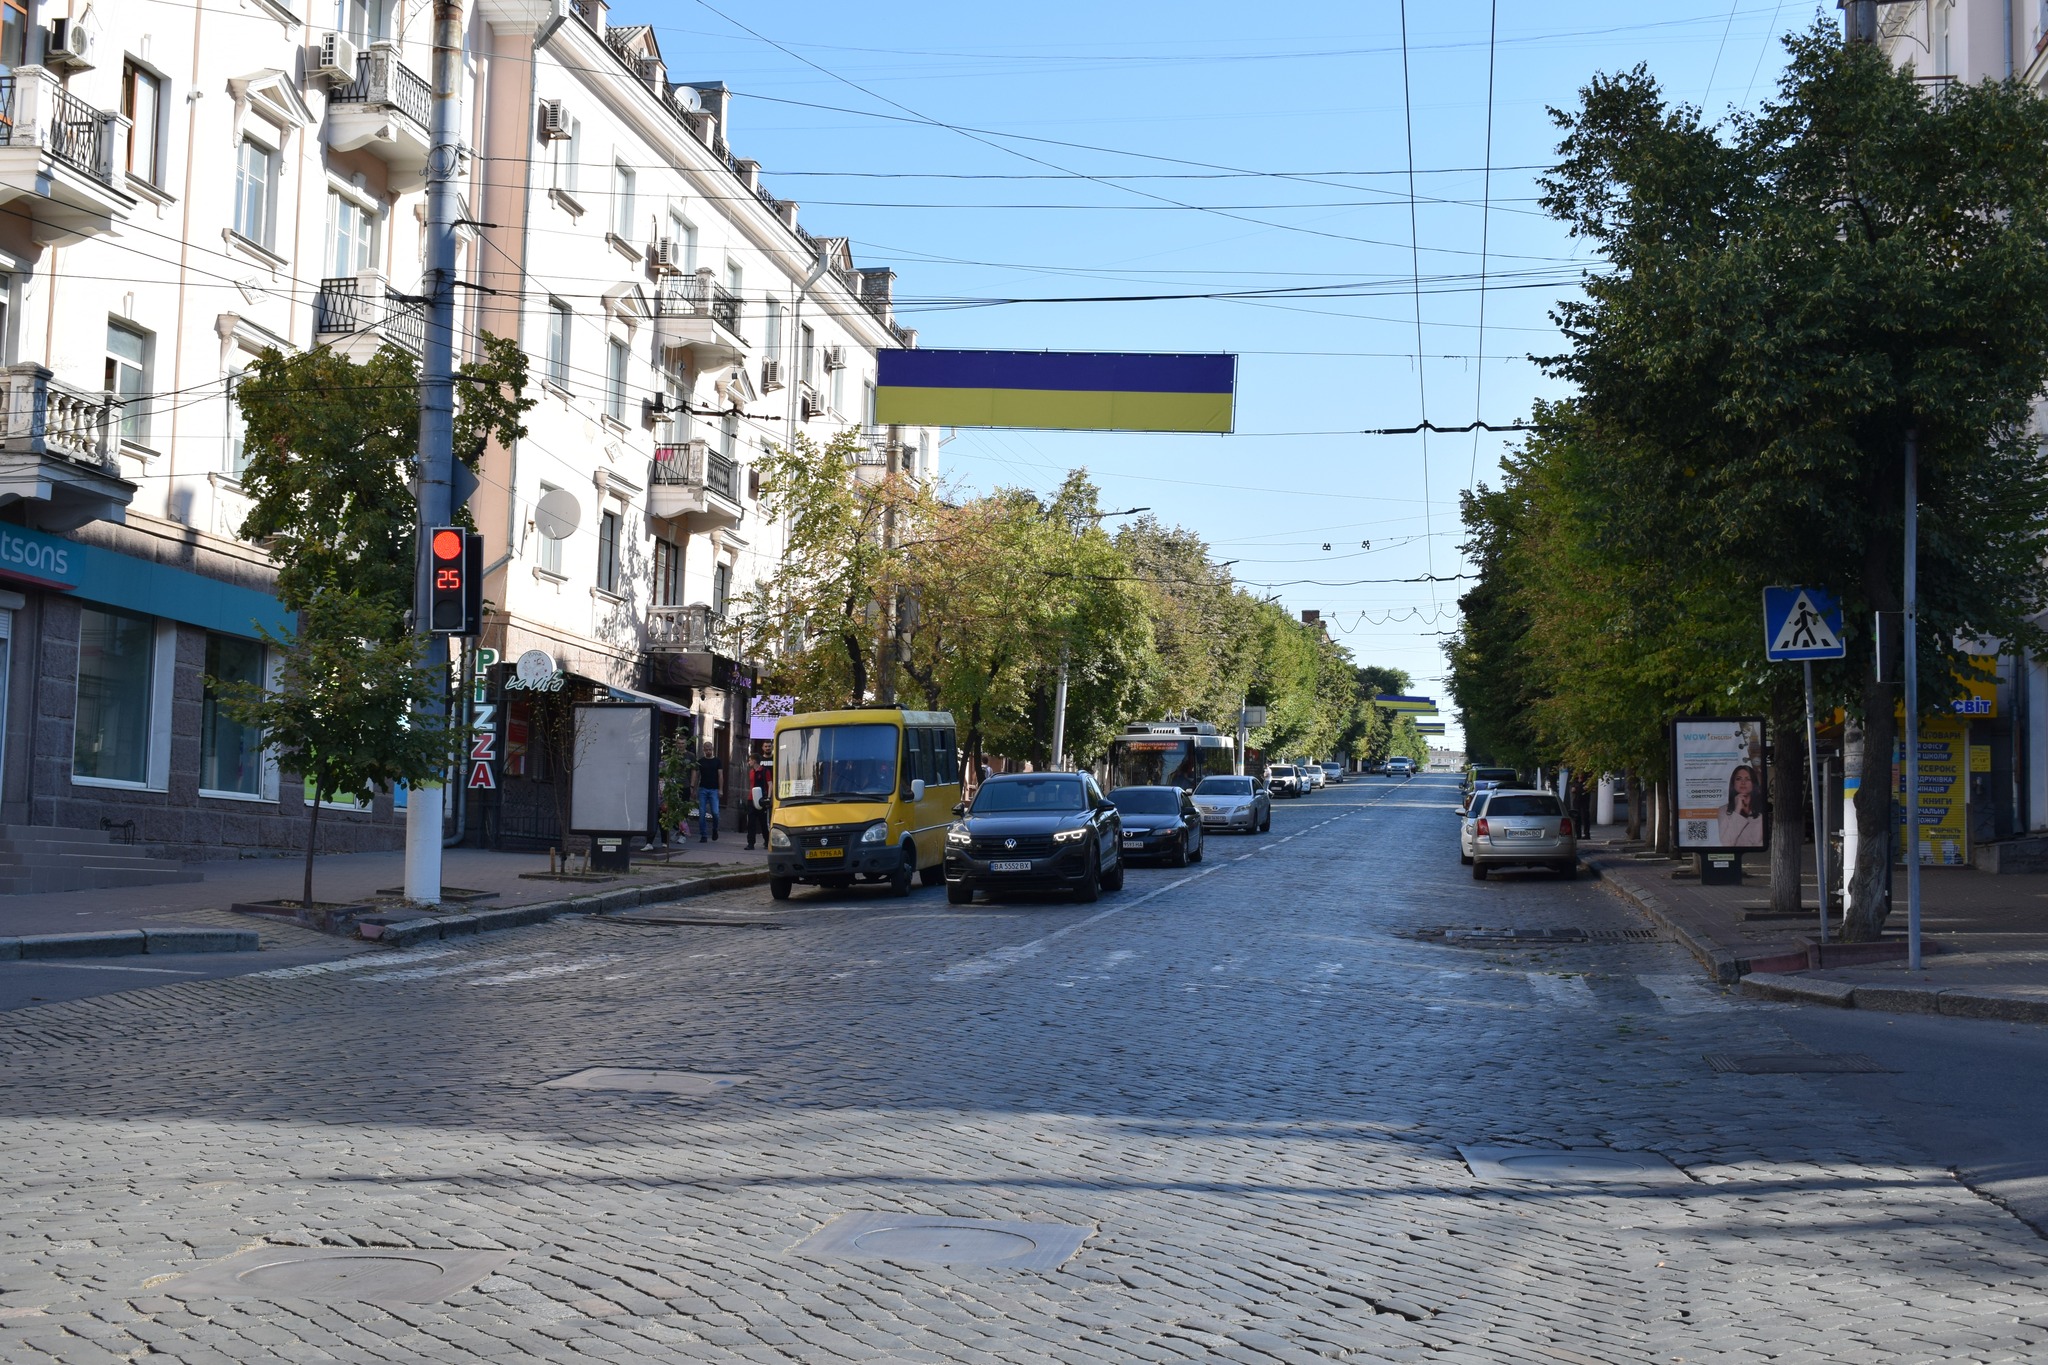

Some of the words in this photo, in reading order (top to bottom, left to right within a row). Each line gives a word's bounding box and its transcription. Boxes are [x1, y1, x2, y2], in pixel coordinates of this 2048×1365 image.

[1, 530, 68, 574] tsons
[438, 570, 460, 589] 25
[505, 675, 527, 690] La
[468, 648, 500, 789] PIZZA
[1918, 764, 1957, 773] КСЕРОКС
[1923, 797, 1952, 805] КНИГИ
